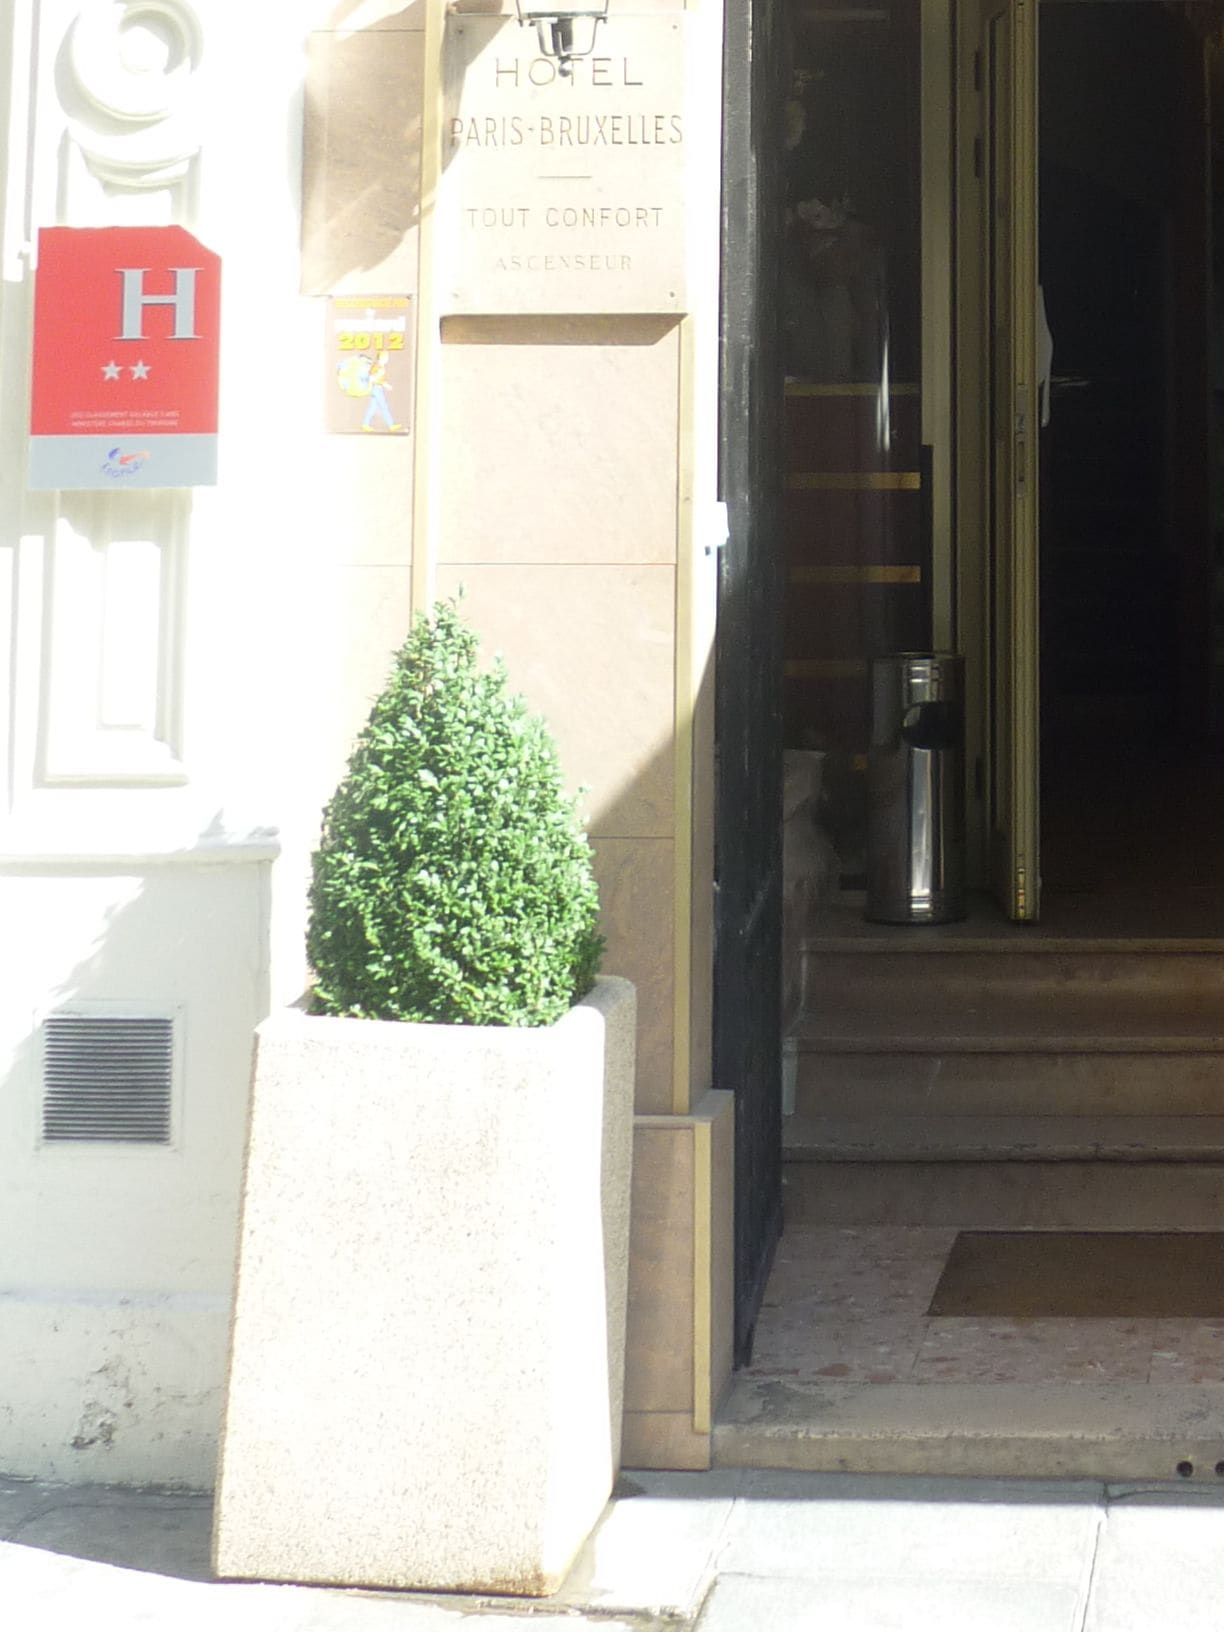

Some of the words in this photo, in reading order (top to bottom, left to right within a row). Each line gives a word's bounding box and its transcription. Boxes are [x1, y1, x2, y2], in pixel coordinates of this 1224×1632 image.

[496, 57, 643, 87] HOTEL
[451, 115, 683, 147] PARIS-BRUXELLES
[467, 208, 530, 228] TOUT
[546, 207, 663, 227] CONFORT
[495, 255, 633, 271] ASCENSEUR
[111, 267, 204, 340] H
[336, 331, 404, 350] 2012
